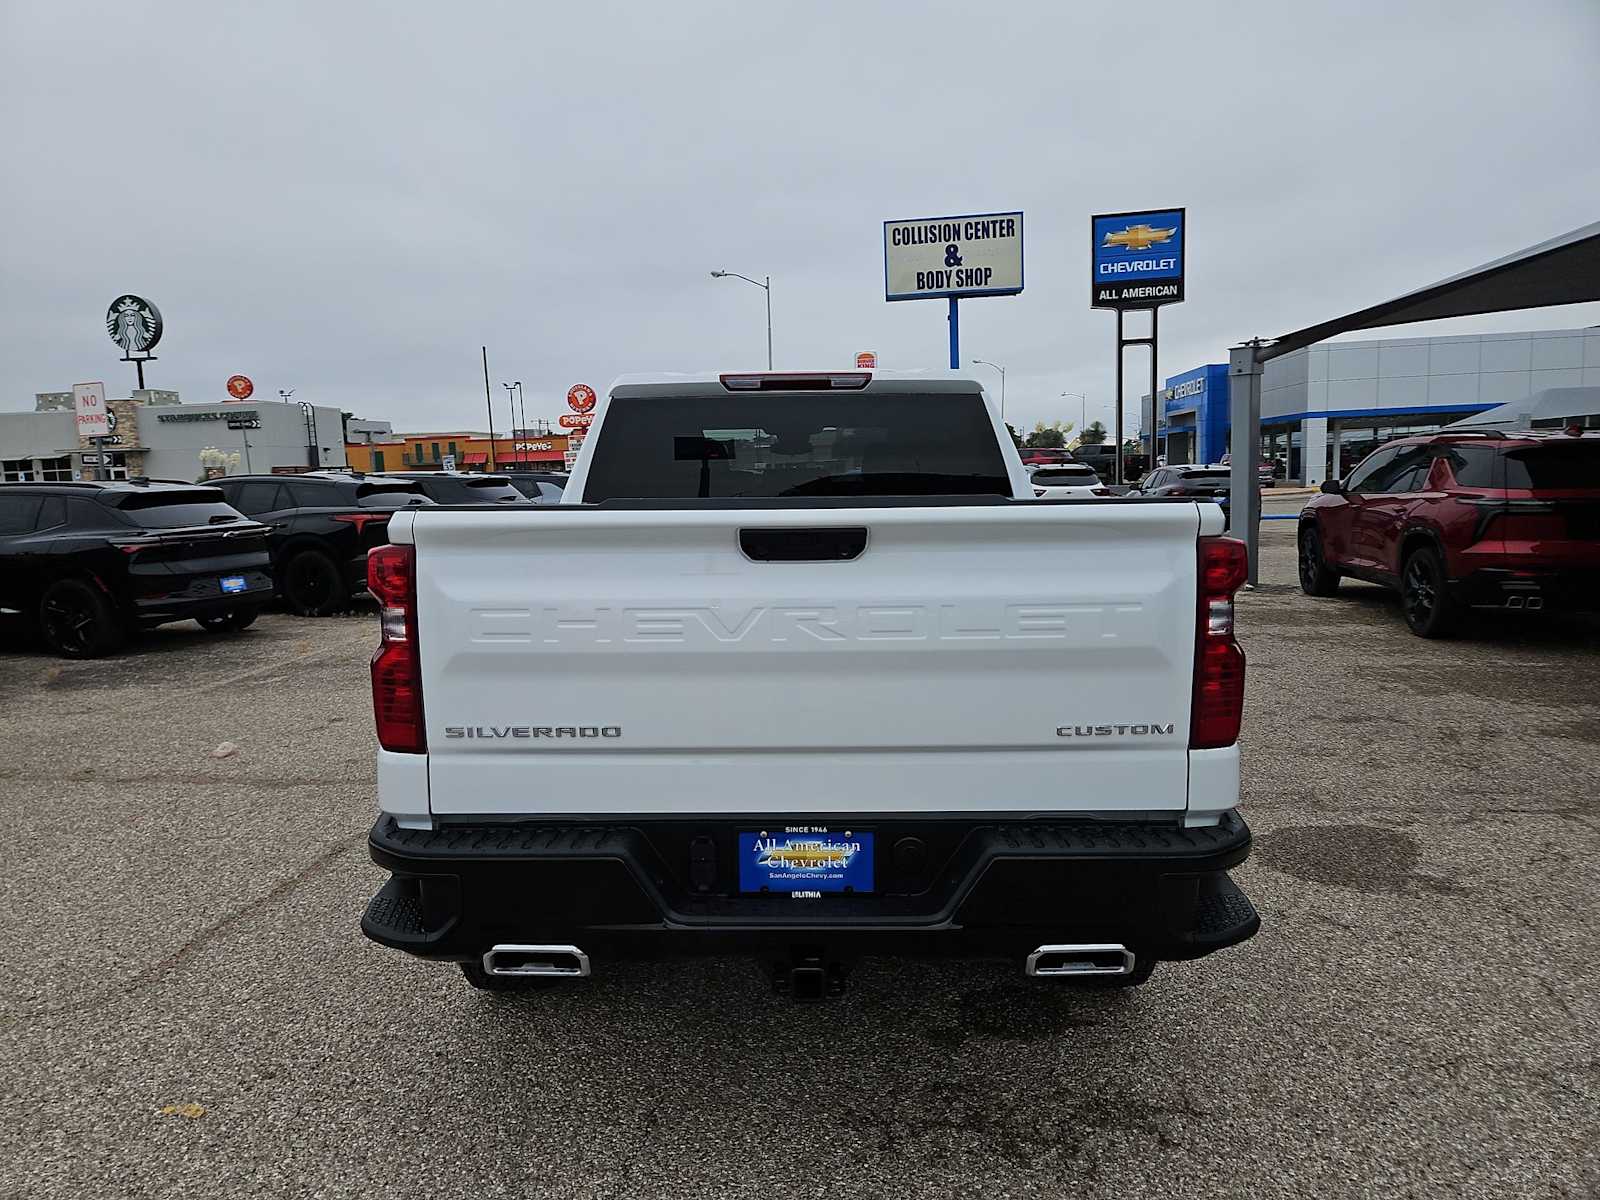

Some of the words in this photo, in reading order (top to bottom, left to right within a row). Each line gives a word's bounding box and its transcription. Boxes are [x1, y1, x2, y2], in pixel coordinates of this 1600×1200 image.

[892, 223, 961, 246] COLLISION
[964, 218, 1015, 241] CENTER
[944, 244, 963, 267] &
[1100, 258, 1176, 274] CHEVROLET
[916, 269, 953, 290] BODY
[955, 267, 992, 288] SHOP
[1098, 289, 1119, 300] ALL
[1121, 285, 1178, 299] AMERICAN
[1174, 377, 1206, 400] CHEVROLET
[82, 395, 97, 407] NO
[77, 413, 106, 425] PARKING
[469, 601, 1143, 642] CHEVROLET
[445, 726, 622, 739] SILVERADO
[1056, 723, 1174, 737] CUSTOM
[753, 838, 776, 852] All
[783, 838, 861, 852] American
[767, 855, 848, 869] Chevrolet
[769, 872, 844, 880] SanAngeloChevy.com
